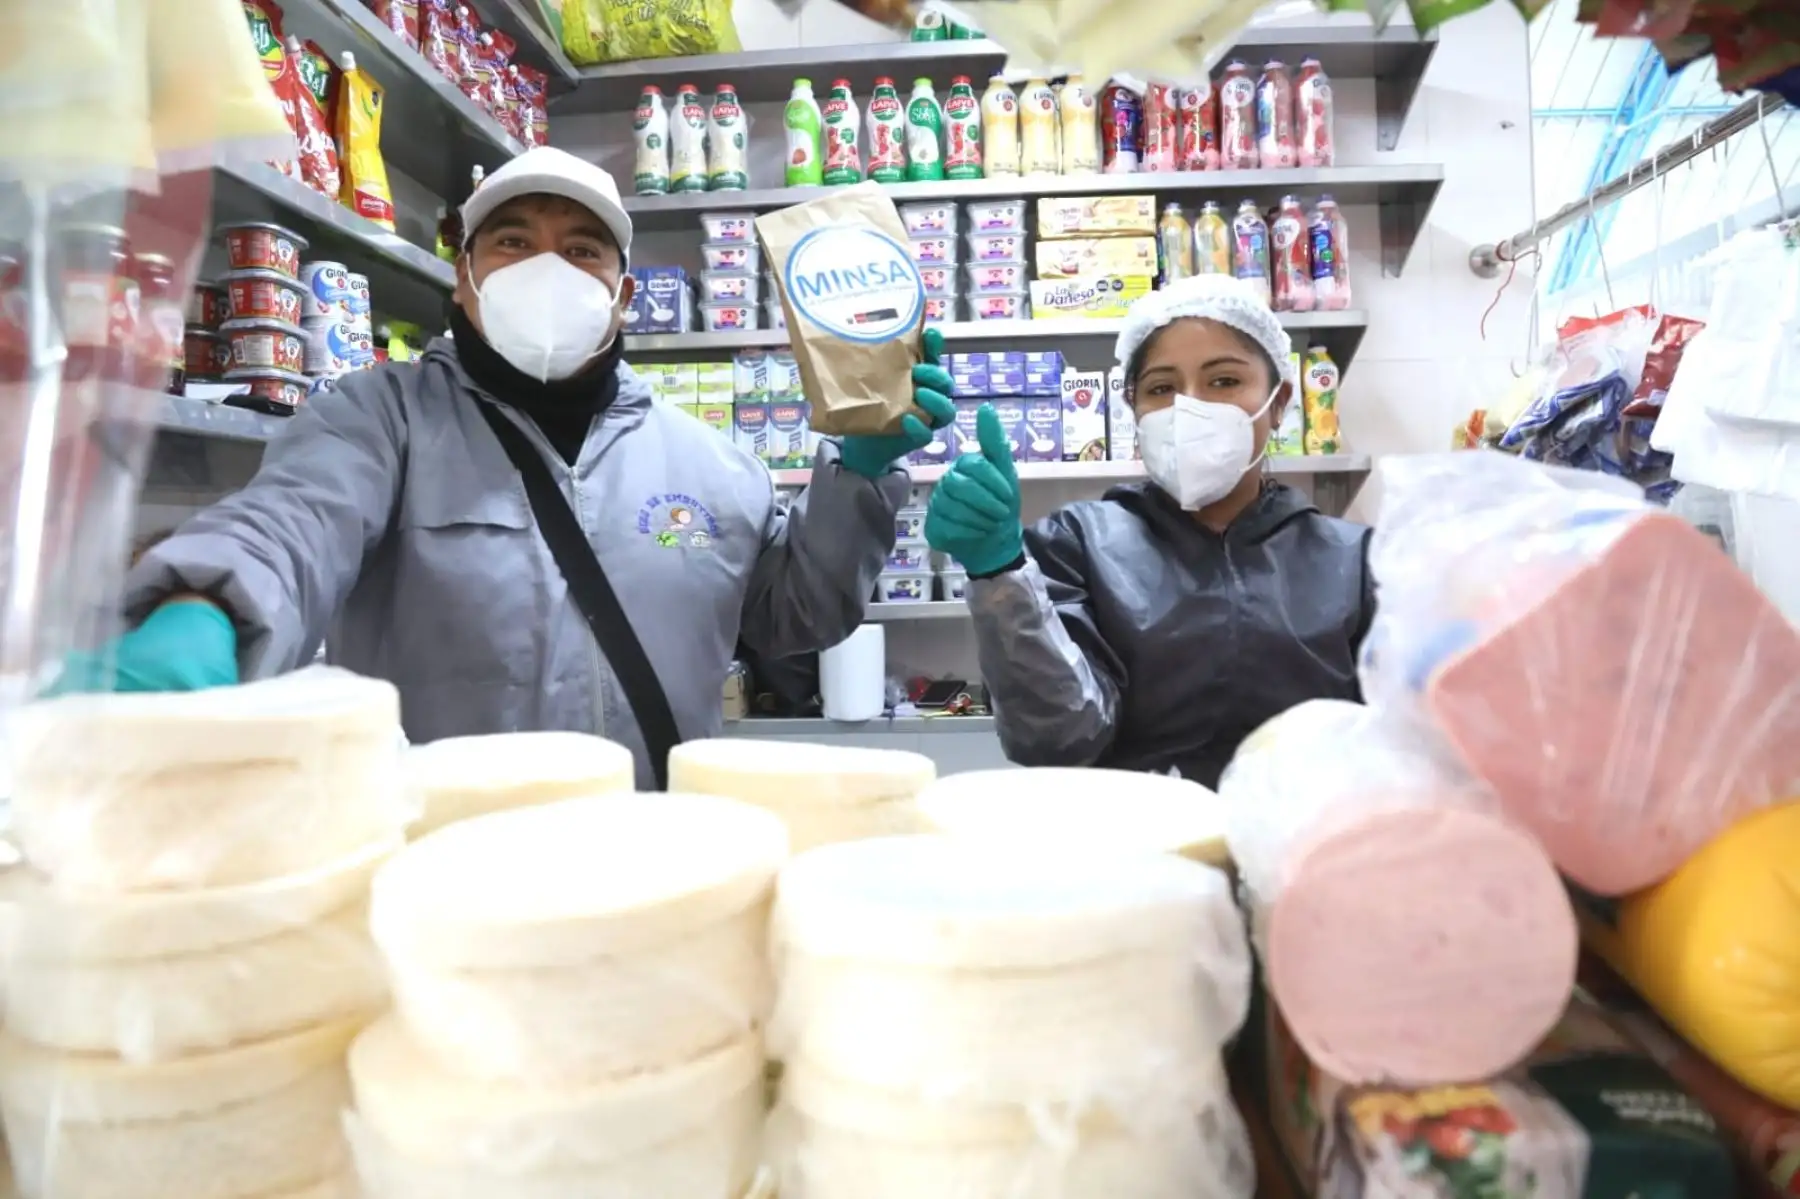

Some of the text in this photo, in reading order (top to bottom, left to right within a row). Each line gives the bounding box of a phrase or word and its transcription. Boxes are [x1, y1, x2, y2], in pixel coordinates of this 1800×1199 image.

[872, 100, 899, 110] LAIVE
[948, 100, 974, 110] LAIVE
[796, 260, 913, 299] MINSA
[1043, 288, 1096, 306] Danesa
[1063, 378, 1102, 391] GLORIA
